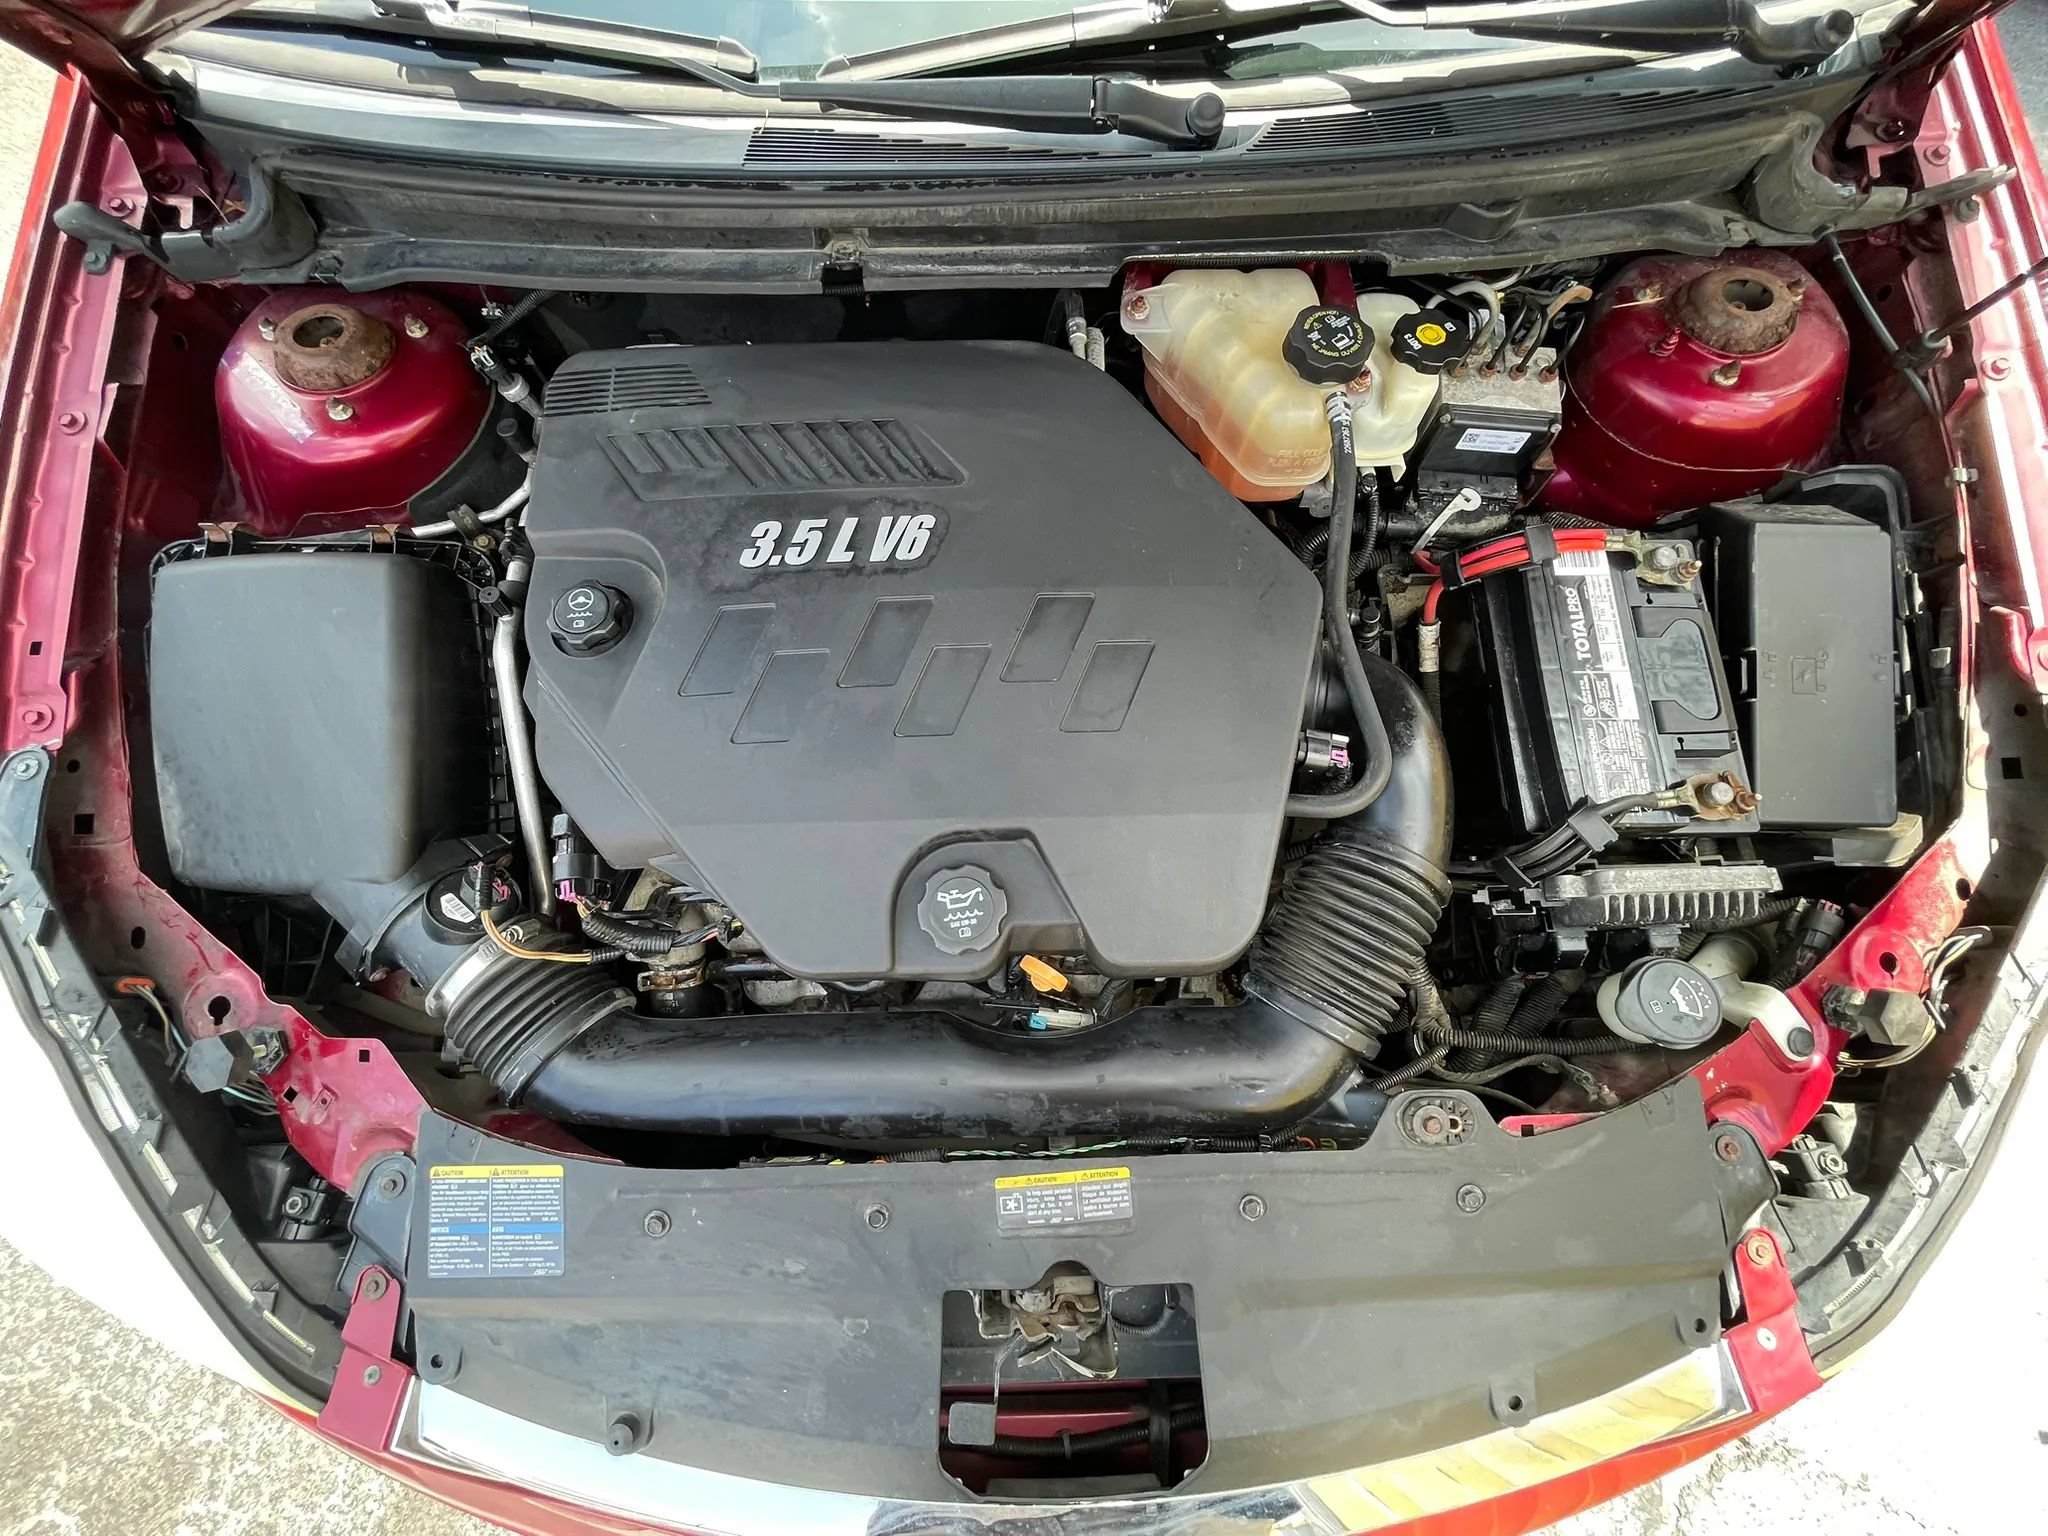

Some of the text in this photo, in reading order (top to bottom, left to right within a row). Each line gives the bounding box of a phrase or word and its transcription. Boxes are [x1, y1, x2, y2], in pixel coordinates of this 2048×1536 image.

[1408, 336, 1422, 350] DOT
[739, 514, 936, 570] 3.5 L V6
[1564, 587, 1592, 661] TOTALPRO
